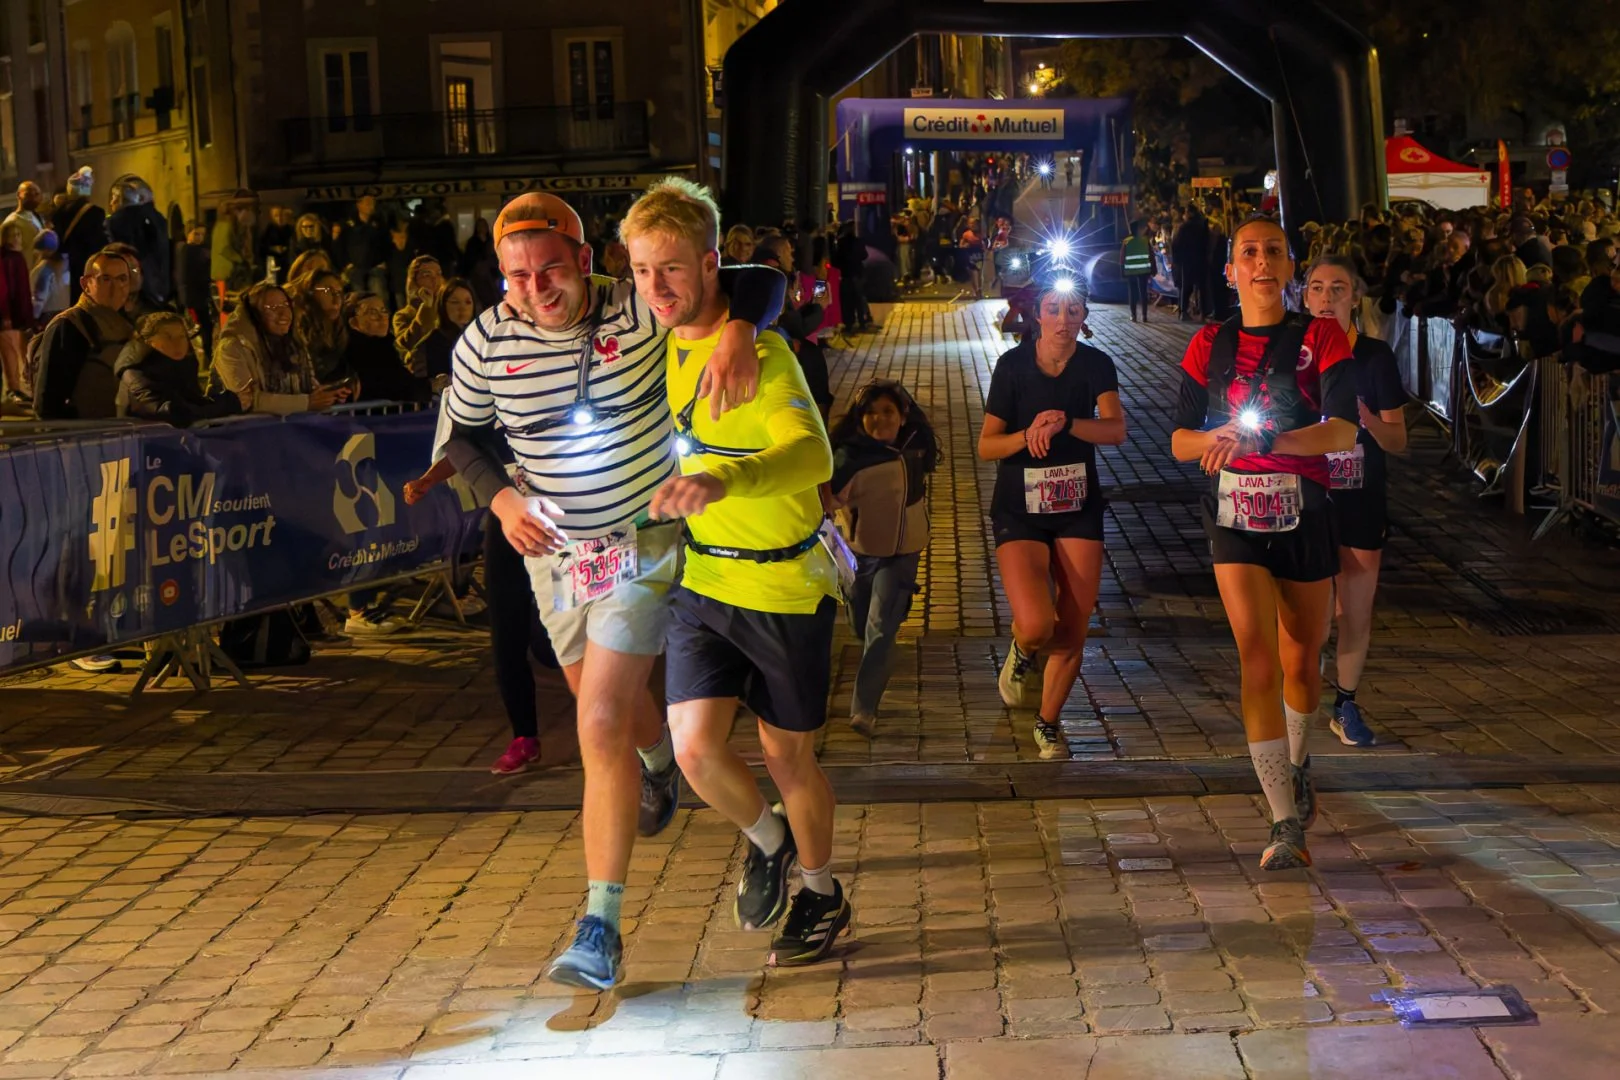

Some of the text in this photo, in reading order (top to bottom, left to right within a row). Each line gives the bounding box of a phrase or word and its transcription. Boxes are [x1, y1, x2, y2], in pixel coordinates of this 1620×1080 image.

[912, 115, 1057, 133] Crédit Mutuel
[503, 175, 637, 191] DAGUET
[146, 456, 162, 470] Le
[147, 472, 272, 526] CM soutient
[1039, 479, 1076, 502] 1278
[1231, 491, 1283, 518] 1504
[568, 548, 620, 592] 1535
